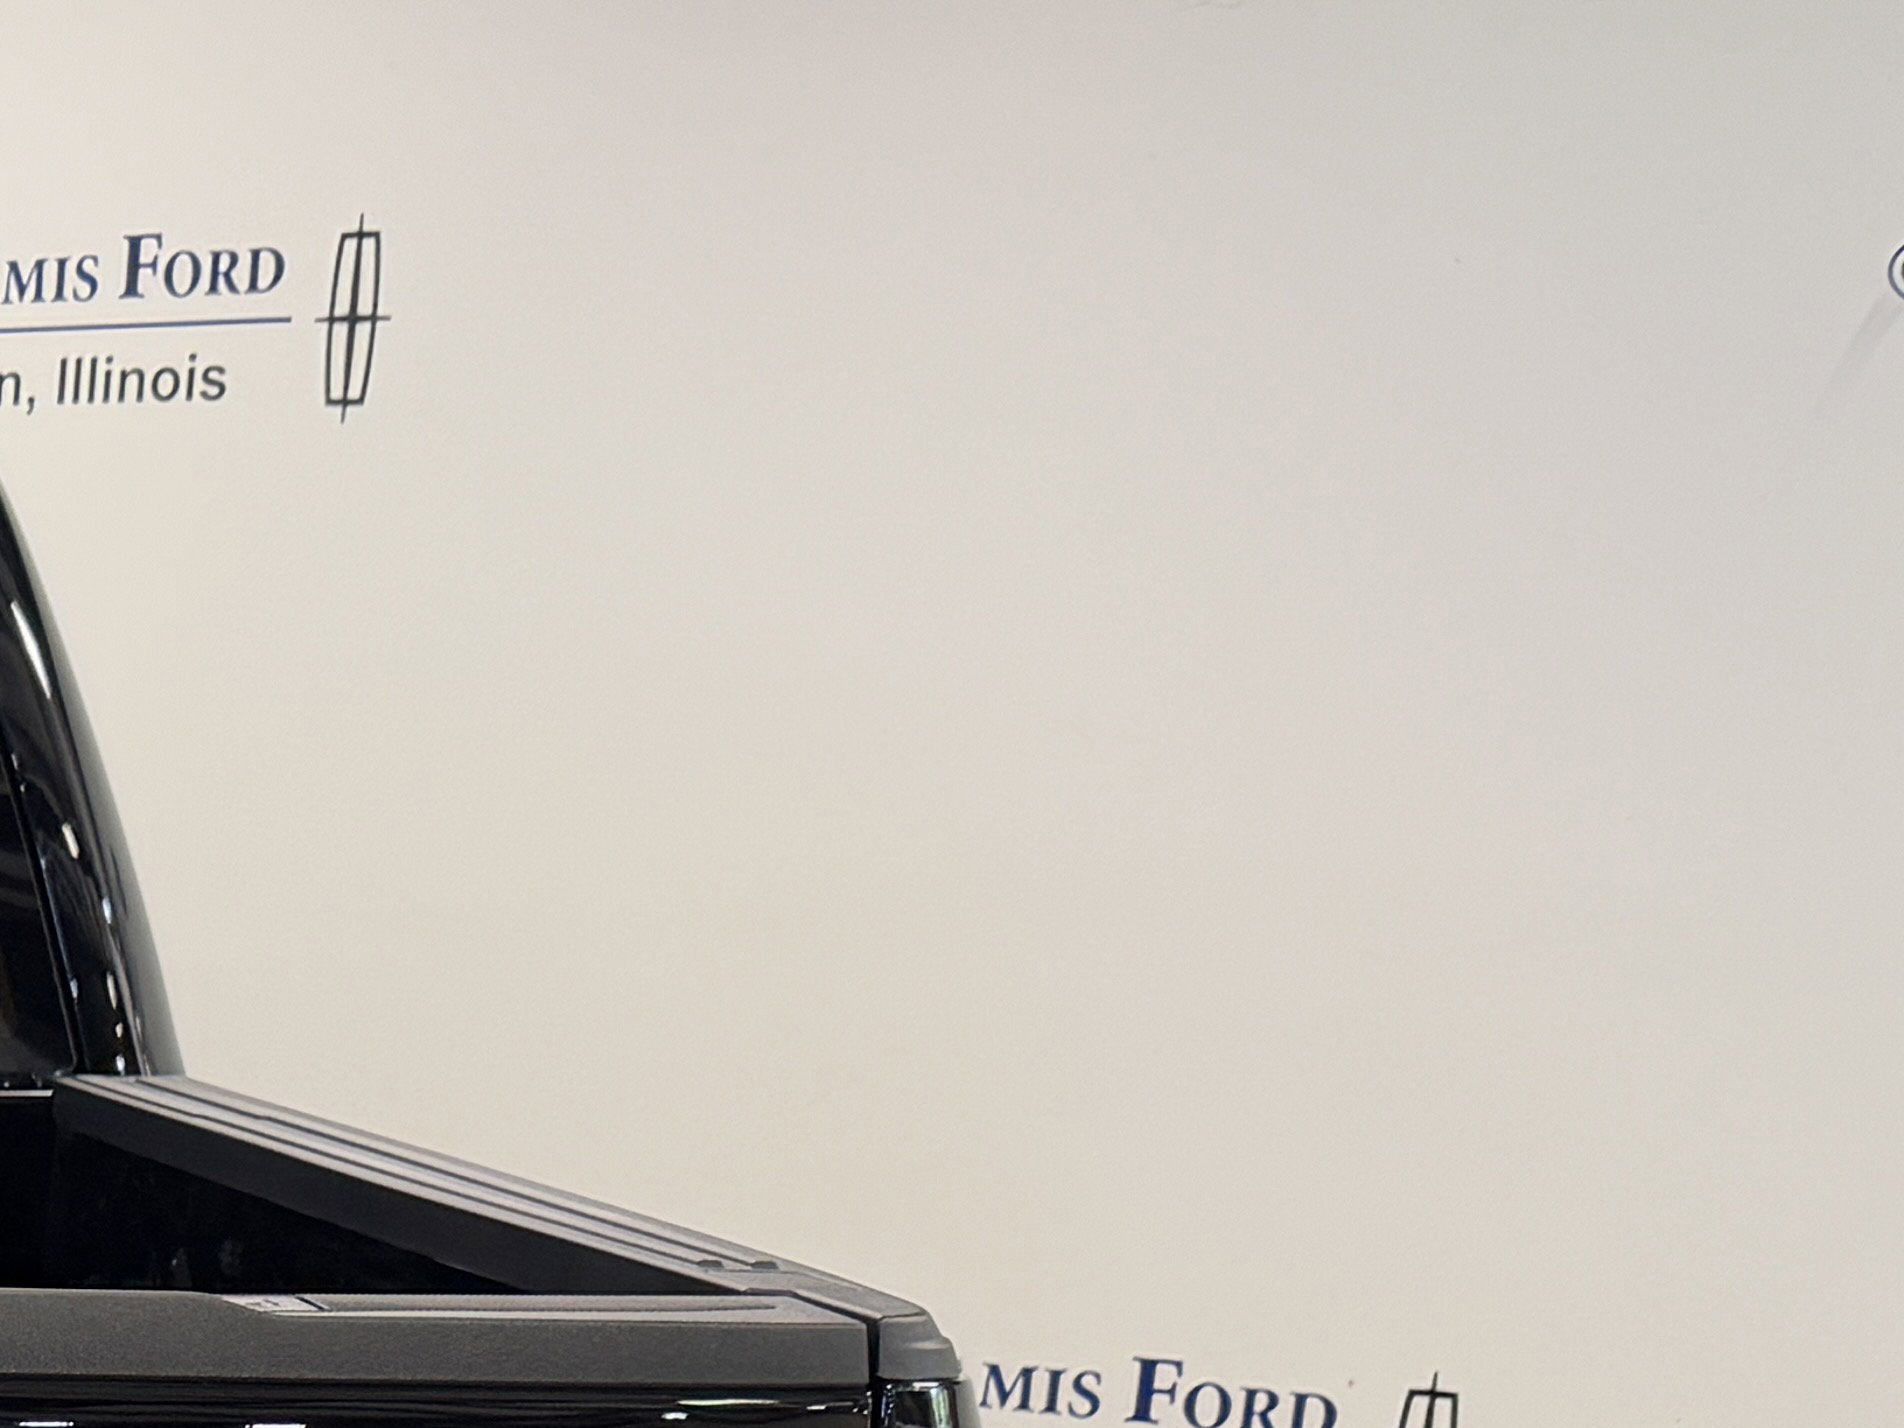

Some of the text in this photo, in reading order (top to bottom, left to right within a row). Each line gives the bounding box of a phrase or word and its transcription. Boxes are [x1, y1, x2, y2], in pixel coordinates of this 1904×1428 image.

[118, 232, 286, 301] FORD
[55, 351, 228, 406] Illinois
[977, 1361, 1103, 1420] MIS
